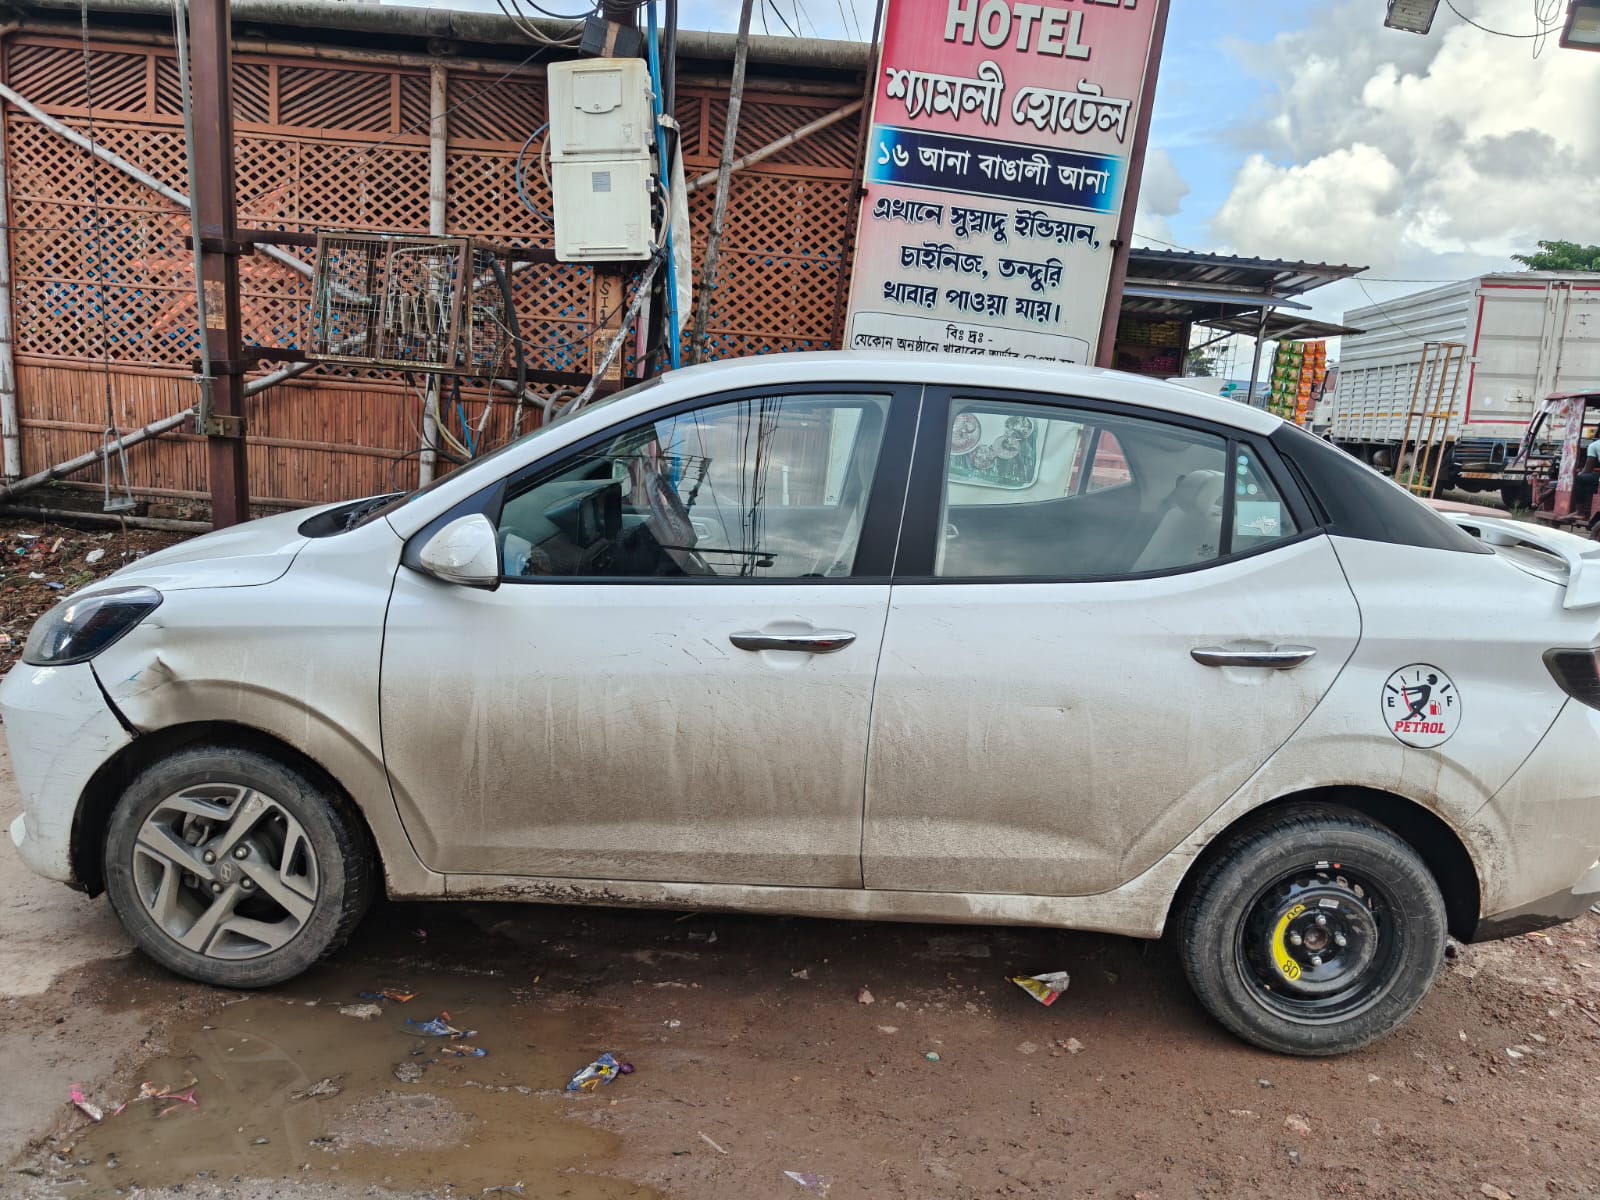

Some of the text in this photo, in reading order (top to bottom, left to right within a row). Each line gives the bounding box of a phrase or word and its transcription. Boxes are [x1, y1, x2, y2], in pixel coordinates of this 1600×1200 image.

[944, 0, 1090, 60] HOTEL
[886, 60, 1131, 143] শ্যামলী হোটেল
[877, 141, 1110, 194] ১৬ আনা বাঙালী আনা
[873, 198, 944, 225] এখানে
[951, 206, 1008, 244] সুস্বাদু
[900, 242, 1063, 294] চাইনিজ, তন্দুরি
[883, 281, 938, 308] খাবার
[854, 333, 893, 350] যেকোন
[1387, 697, 1395, 707] E
[1446, 696, 1453, 707] F
[1394, 721, 1445, 734] PETROL
